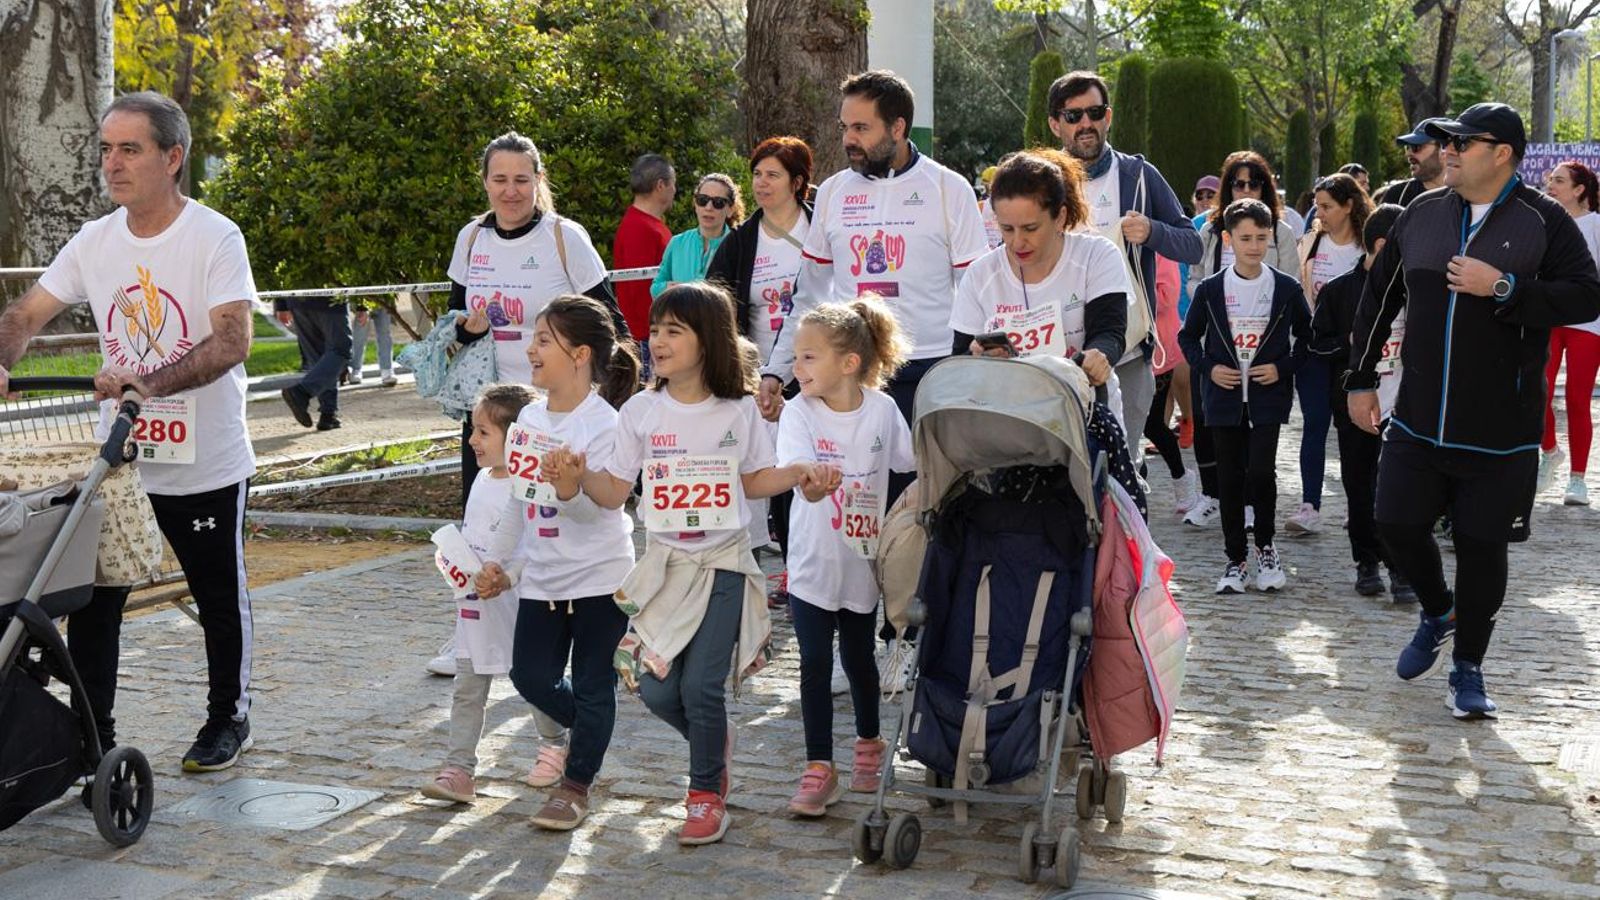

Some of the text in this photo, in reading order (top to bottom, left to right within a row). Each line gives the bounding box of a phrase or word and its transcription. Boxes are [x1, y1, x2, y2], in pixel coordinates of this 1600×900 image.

[1571, 144, 1600, 155] VENC
[1523, 158, 1544, 169] POR
[1233, 333, 1264, 349] 42
[134, 417, 187, 444] 280
[650, 434, 677, 447] XXVII
[653, 483, 731, 511] 5225
[845, 513, 880, 538] 5234
